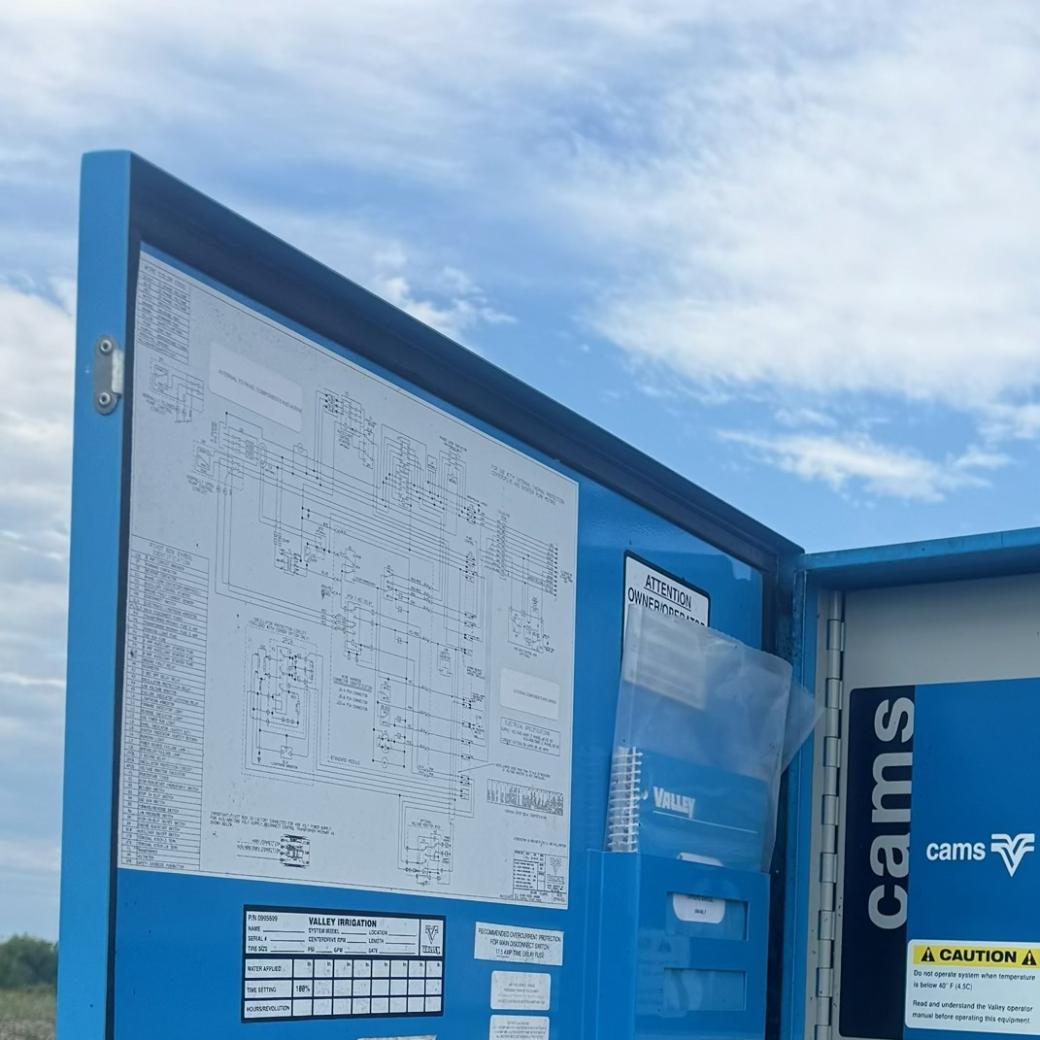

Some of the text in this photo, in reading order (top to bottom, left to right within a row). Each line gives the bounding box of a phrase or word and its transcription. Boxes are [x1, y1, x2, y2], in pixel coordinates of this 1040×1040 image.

[646, 574, 692, 608] ATTENTION
[654, 786, 696, 819] VALLEY
[868, 697, 915, 930] cams
[926, 841, 986, 861] cams
[309, 917, 377, 927] VALLEY IRRIGATION
[940, 949, 1017, 963] CAUTION
[934, 971, 957, 979] operate
[987, 1003, 1005, 1012] Valley
[955, 1014, 983, 1023] operating
